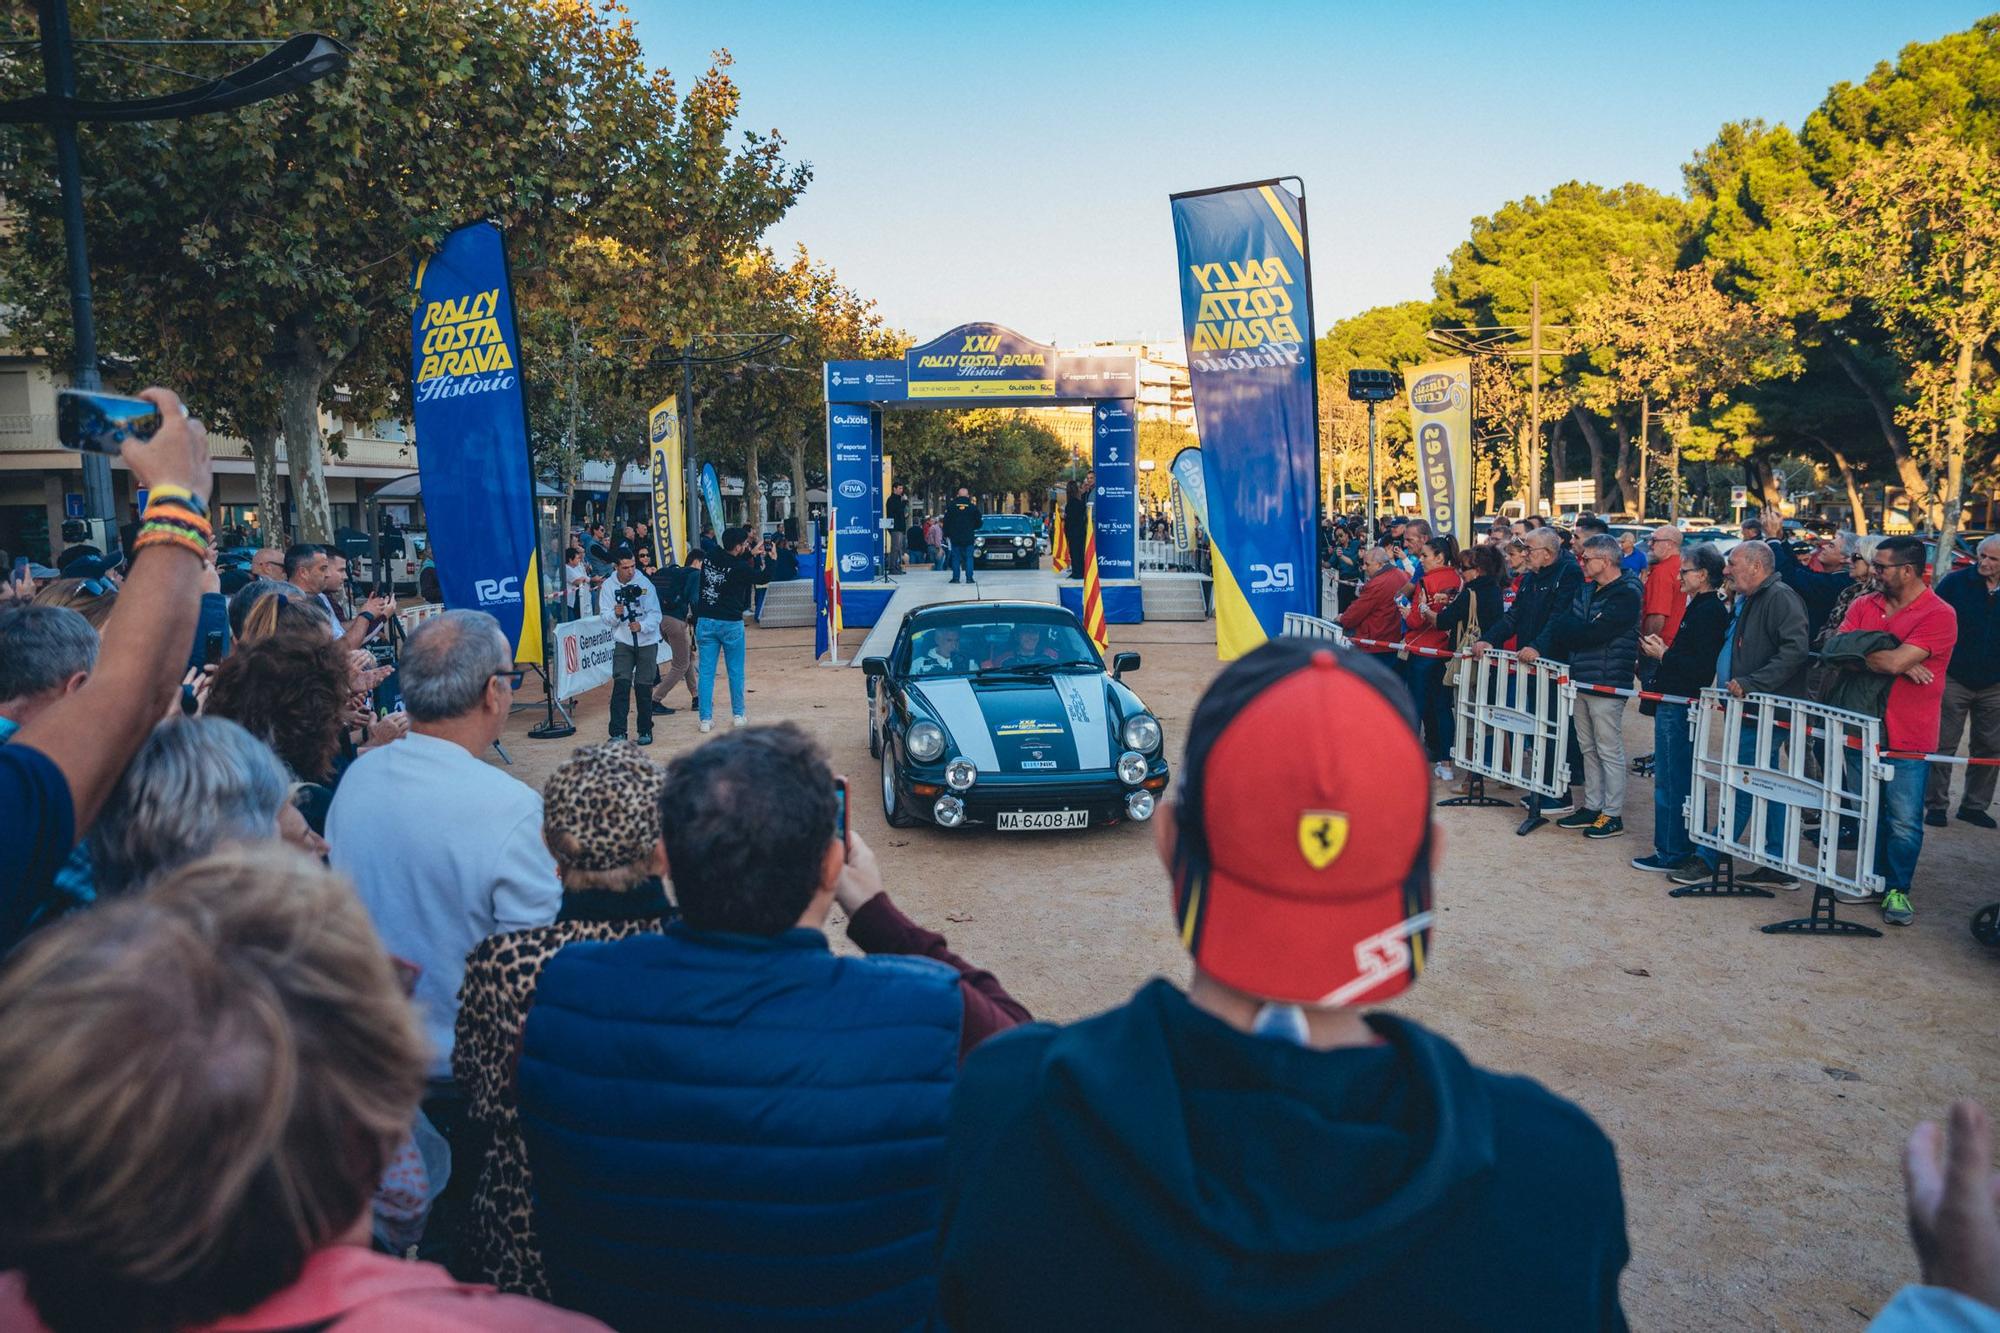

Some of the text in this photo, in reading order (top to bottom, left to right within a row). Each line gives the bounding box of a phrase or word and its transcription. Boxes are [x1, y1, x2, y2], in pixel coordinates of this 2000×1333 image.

[421, 288, 499, 330] RALLY
[422, 317, 503, 355] COSTA
[960, 335, 1002, 352] XXII
[417, 342, 514, 383] BRAVA
[918, 353, 1045, 368] RALLY COSTA BRAVA
[416, 370, 516, 402] Històric
[475, 576, 520, 601] RC
[582, 655, 591, 669] de
[999, 812, 1087, 829] MA-6408-AM
